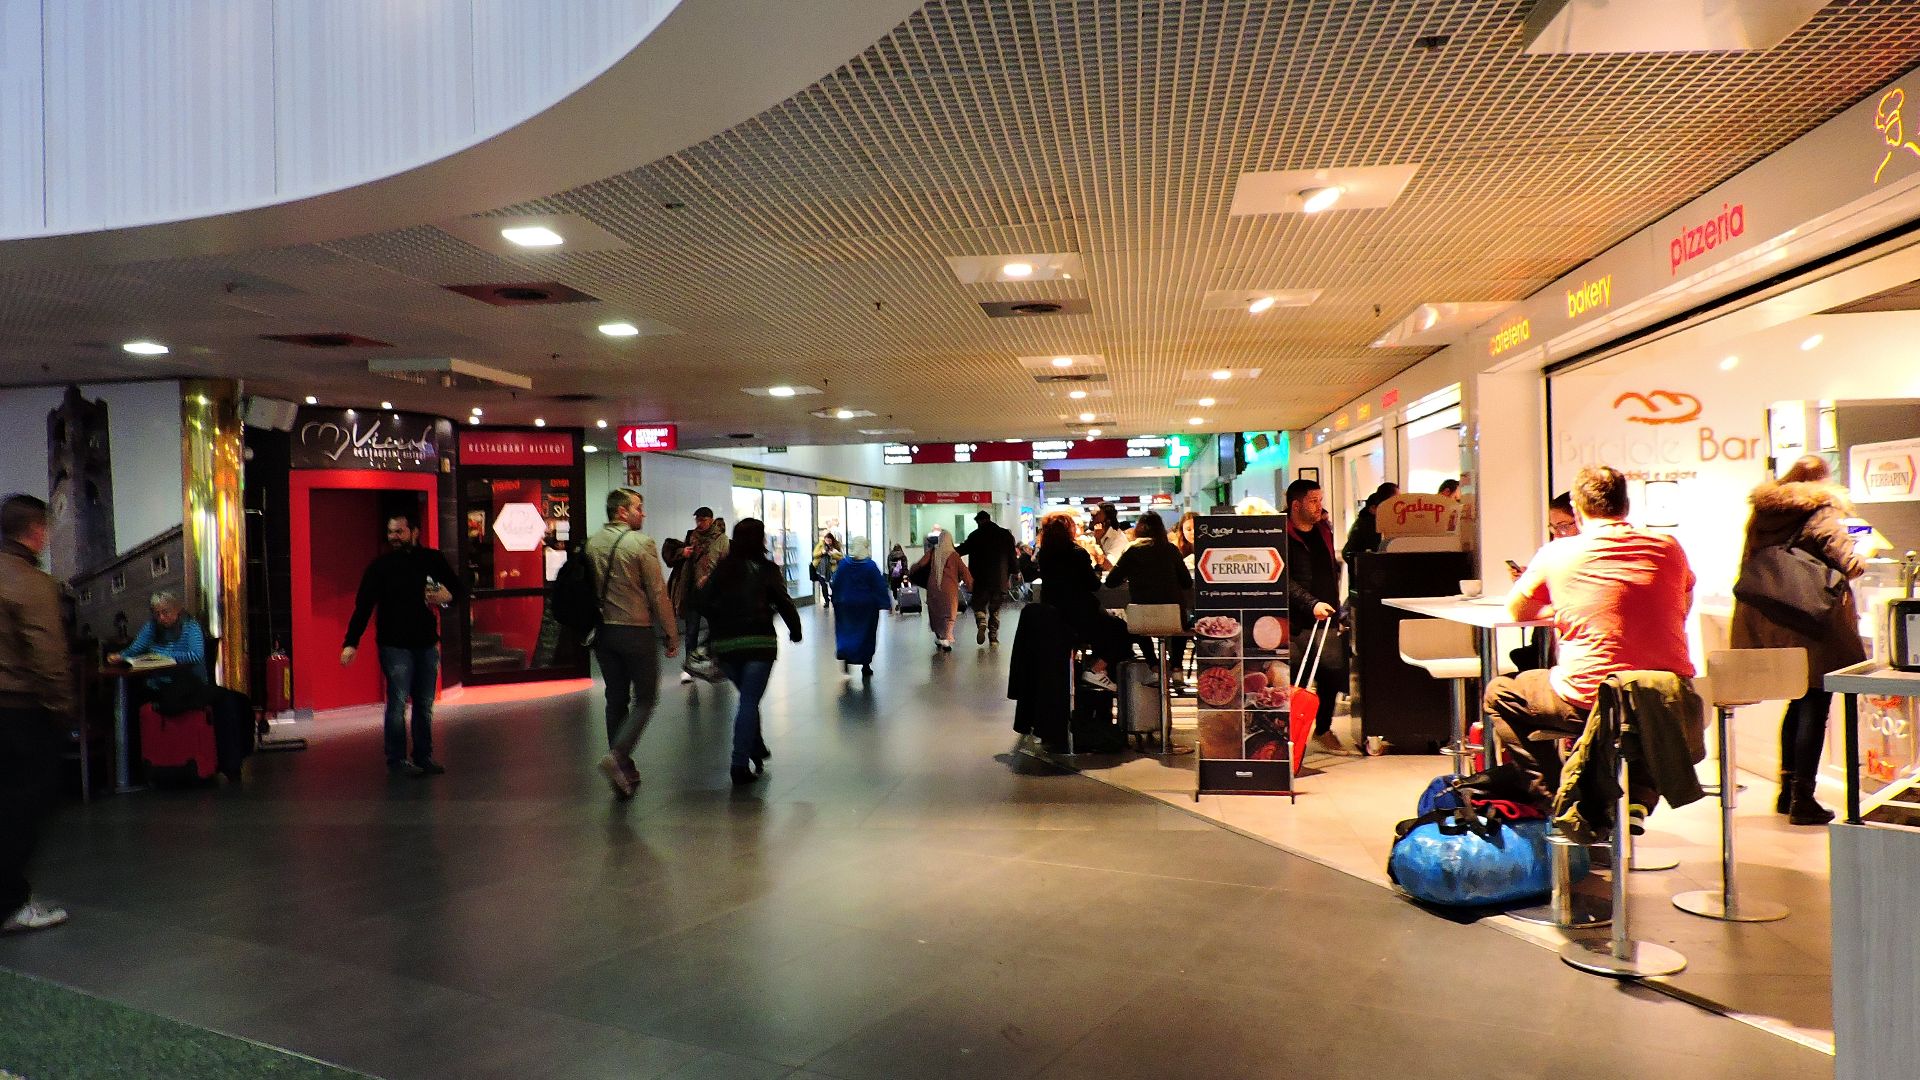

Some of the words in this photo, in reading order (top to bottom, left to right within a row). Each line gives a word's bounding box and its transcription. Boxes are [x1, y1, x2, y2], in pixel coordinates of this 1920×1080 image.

[1670, 203, 1744, 275] pizzeria
[1567, 274, 1613, 319] bakery
[468, 443, 525, 454] RESTAURANT
[529, 443, 566, 454] BISTROT
[1698, 426, 1761, 462] Bar
[1871, 471, 1910, 488] FERRARINI
[1394, 499, 1445, 525] Galup
[1211, 562, 1271, 575] FERRARINI
